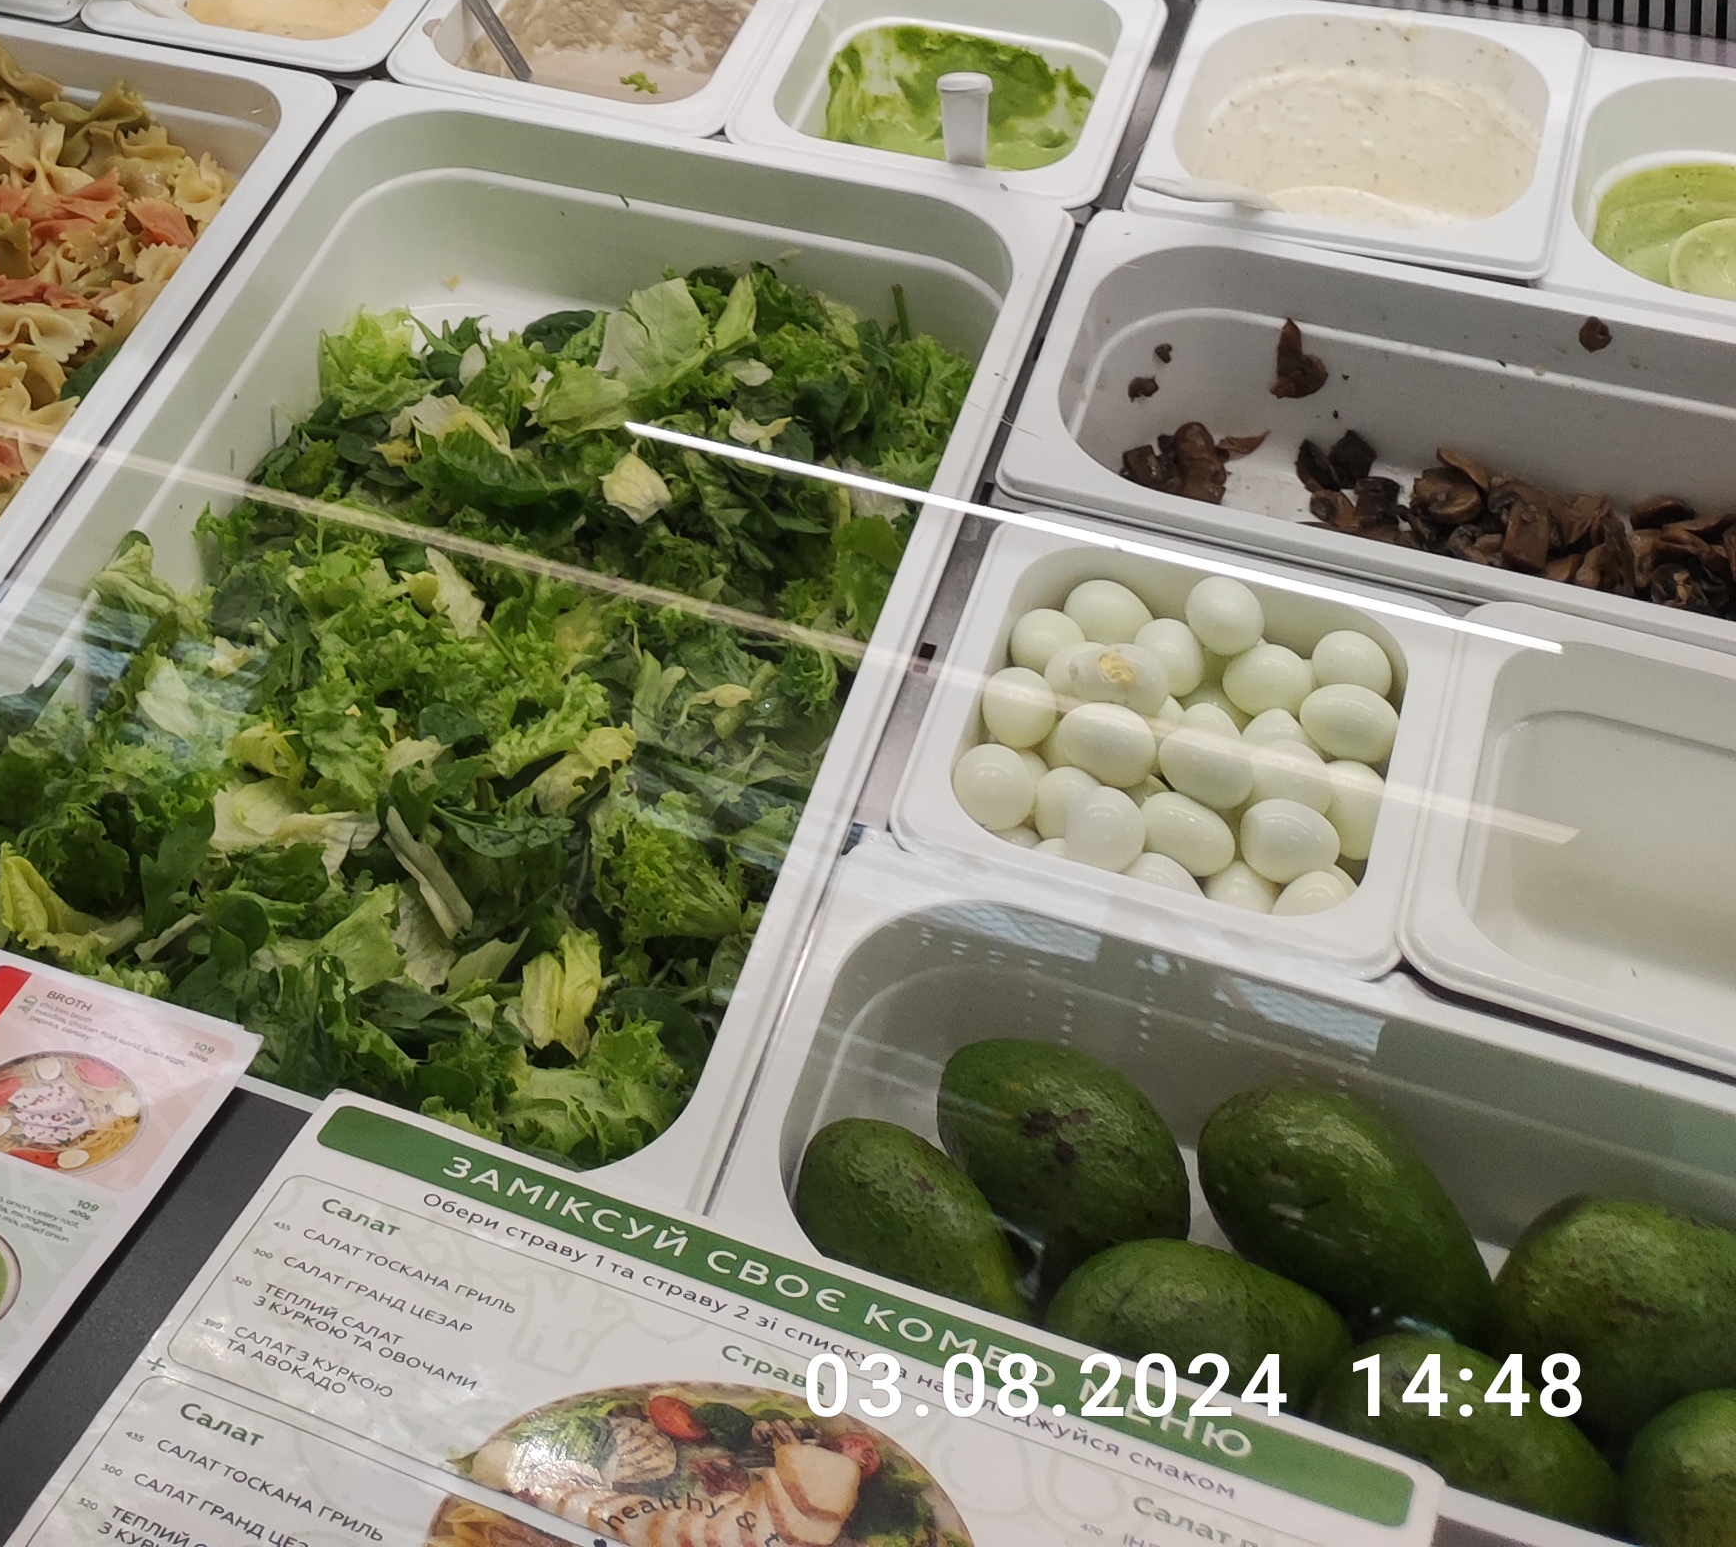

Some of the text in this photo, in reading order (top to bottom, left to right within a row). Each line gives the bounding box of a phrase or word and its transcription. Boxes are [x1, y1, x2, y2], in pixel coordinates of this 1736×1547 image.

[46, 989, 94, 1012] BROTH
[321, 1197, 402, 1237] Салат
[442, 1155, 691, 1259] ЗАМІКСУЙ
[706, 1249, 848, 1315] СВОЄ
[302, 1227, 364, 1258] САЛАТ
[364, 1250, 450, 1292] ТОСКАНА
[454, 1283, 517, 1315] ГРИЛЬ
[264, 1282, 339, 1320] ТЕПЛИЙ
[344, 1279, 407, 1314] ГРАНД
[409, 1303, 473, 1334] ЦЕЗАР
[268, 1300, 478, 1391] КУРКОЮ ОВОЧАМИ
[423, 1192, 500, 1233] Обери
[505, 1224, 590, 1265] страву
[595, 1253, 606, 1269] 1
[610, 1262, 636, 1281] та
[642, 1273, 729, 1314] страву
[734, 1304, 751, 1321] 2
[754, 1313, 778, 1333] зі
[1129, 1448, 1236, 1500] смаком
[249, 1348, 347, 1395] АВОКАДО
[311, 1357, 394, 1398] КУРКОЮ
[179, 1401, 265, 1448] Салат
[599, 1491, 725, 1532] healthy
[1131, 1495, 1233, 1546] Салат
